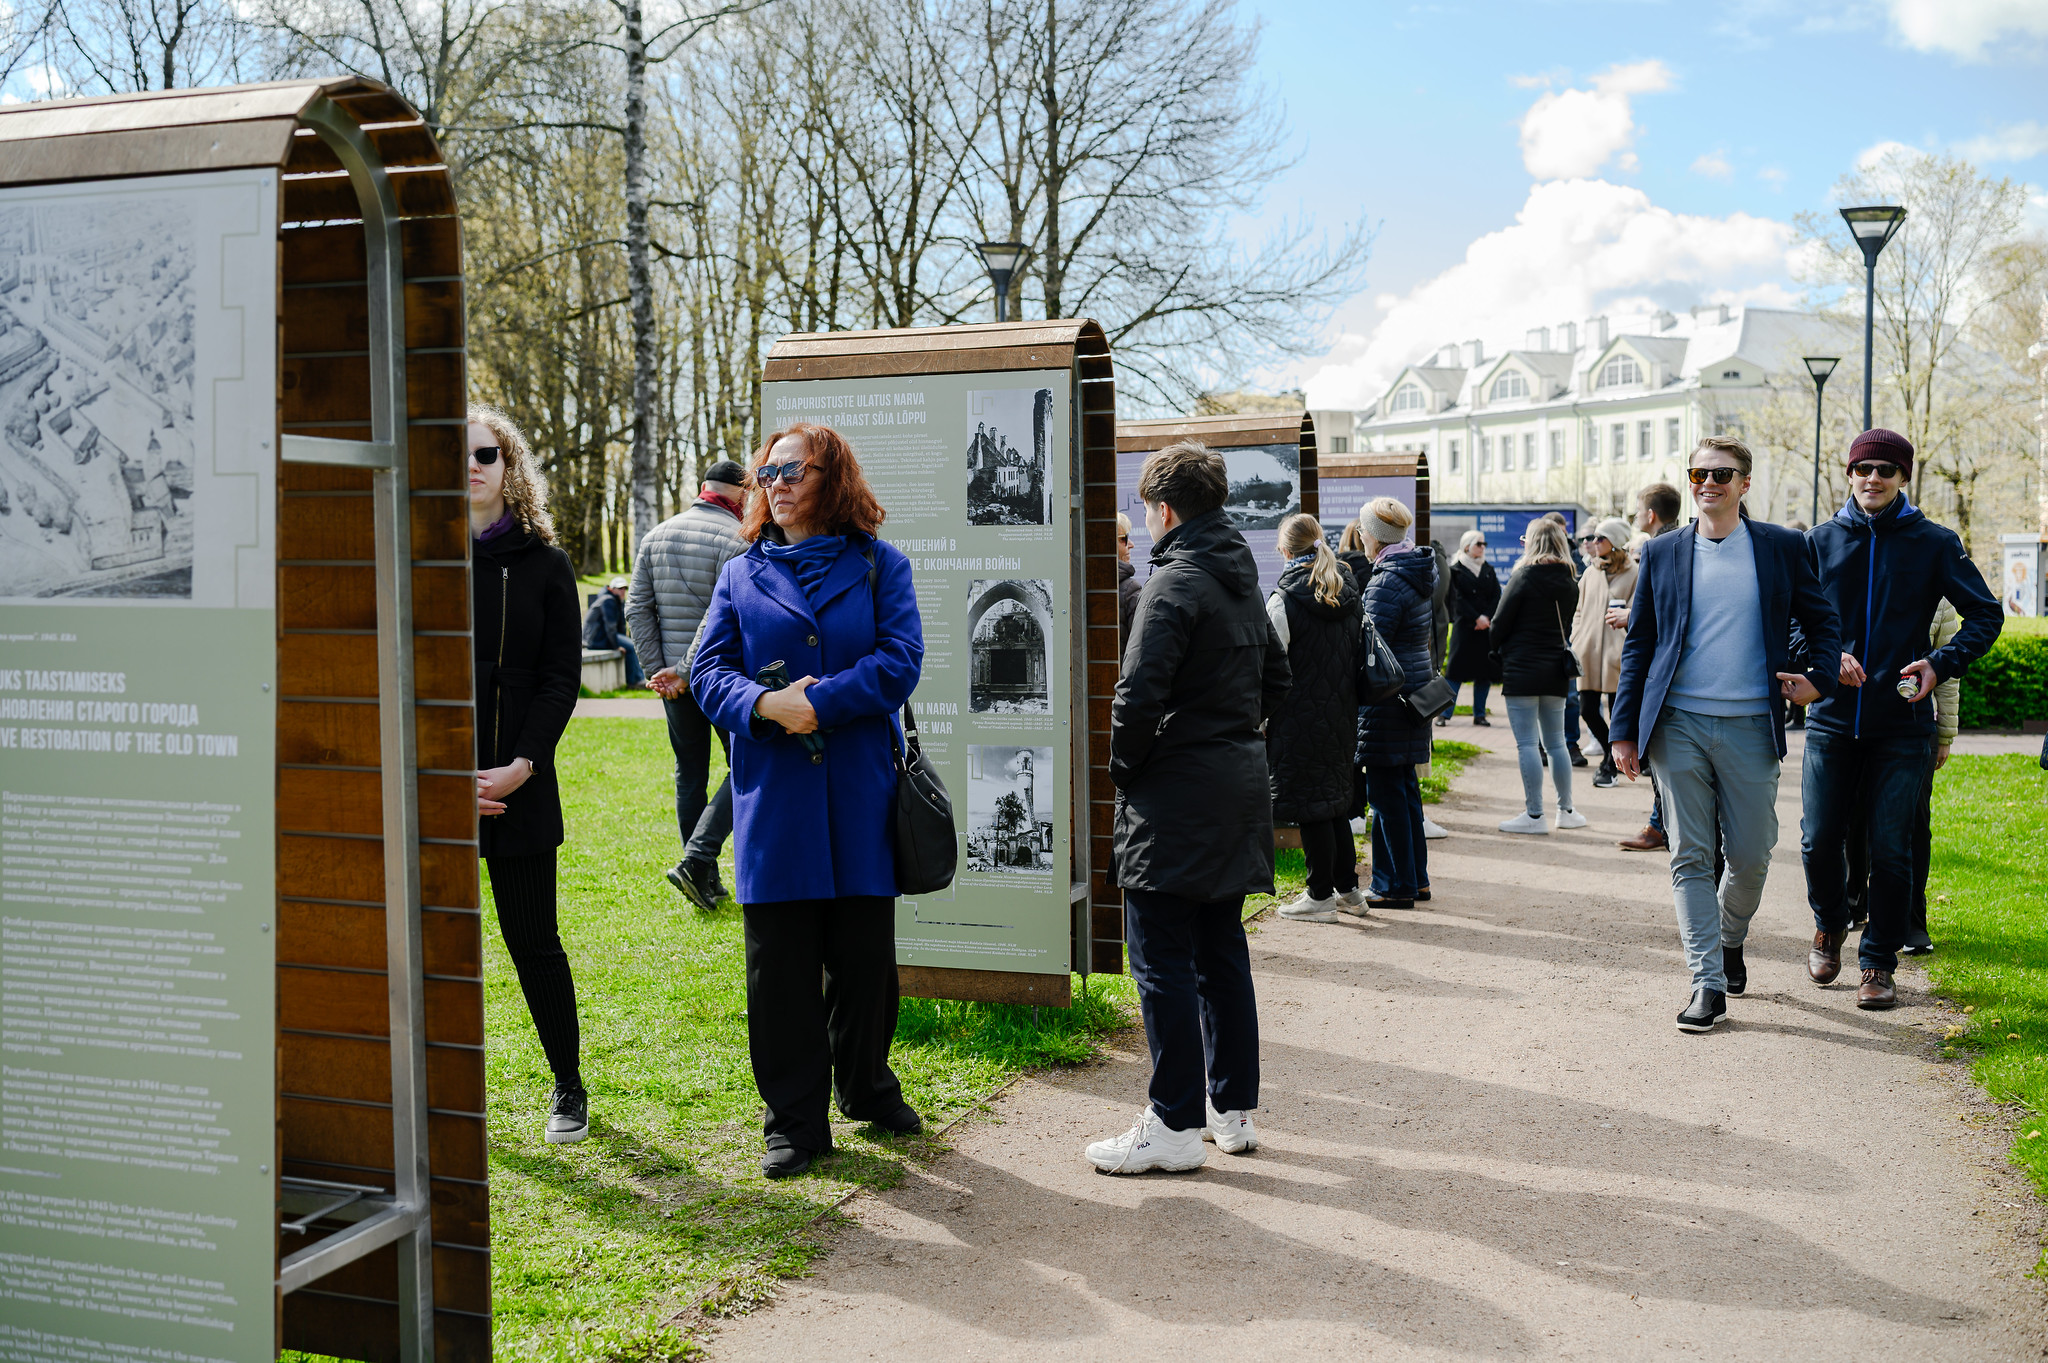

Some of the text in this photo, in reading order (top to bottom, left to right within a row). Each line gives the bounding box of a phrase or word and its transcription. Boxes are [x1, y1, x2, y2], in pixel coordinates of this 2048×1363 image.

[776, 392, 925, 410] SÕJAPURUSTUSTE ULATUS NARVA
[835, 412, 870, 427] PÄRAST
[872, 410, 894, 426] SÕJA
[897, 409, 926, 425] LÕPPU
[889, 537, 956, 552] ЗРУШЕНИЙ В
[924, 558, 982, 571] ОКОНЧАНИЯ
[985, 555, 1020, 570] ВОЙНЫ
[24, 670, 126, 693] TAASTAMISEKS
[77, 701, 138, 723] СТАРОГО
[142, 703, 199, 727] ГОРОДА
[914, 702, 924, 715] IN
[926, 702, 958, 716] NARVA
[915, 721, 953, 734] HE WAR
[21, 728, 111, 751] RESTORATION
[114, 731, 132, 752] OF
[136, 733, 162, 753] THE
[166, 734, 193, 755] OLD
[196, 735, 238, 756] TOWN
